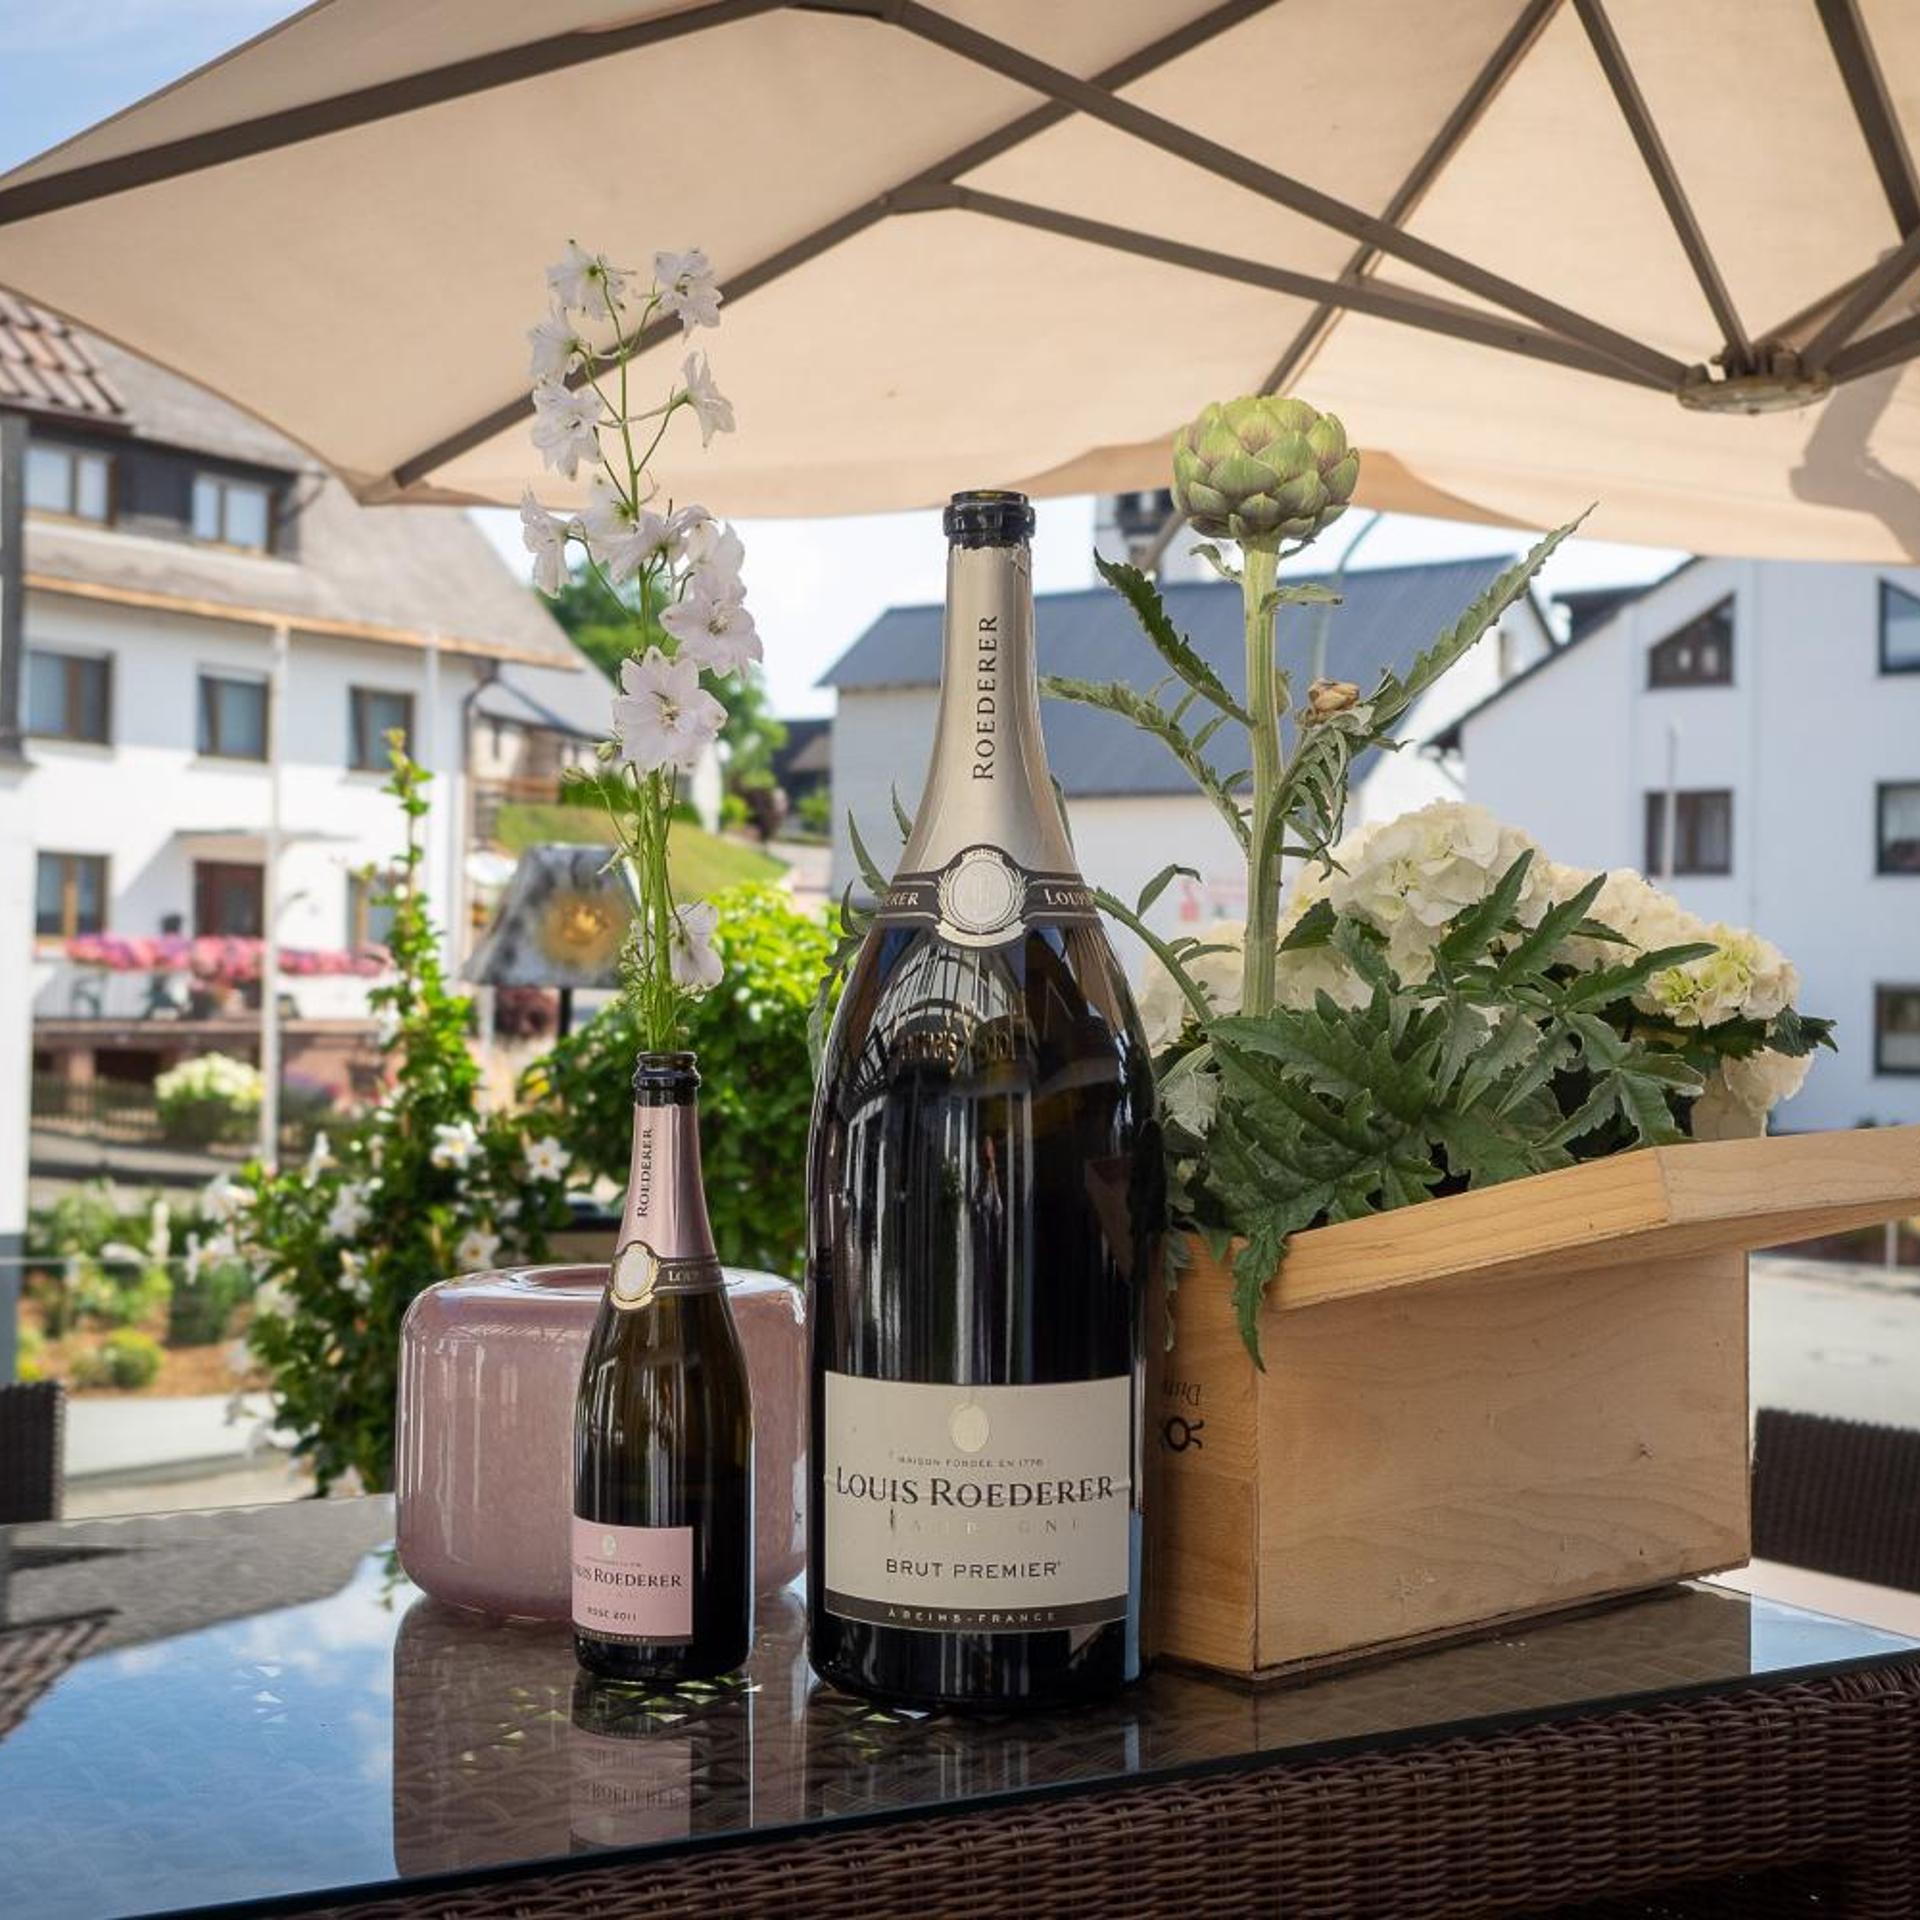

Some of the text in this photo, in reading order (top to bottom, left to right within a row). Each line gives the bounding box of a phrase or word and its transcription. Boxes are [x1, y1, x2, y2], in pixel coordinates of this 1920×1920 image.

[973, 614, 998, 780] ROEDERER
[836, 1466, 1114, 1508] LOUIS ROEDERER
[594, 1567, 682, 1588] ROEDERER
[886, 1558, 943, 1578] BRUT
